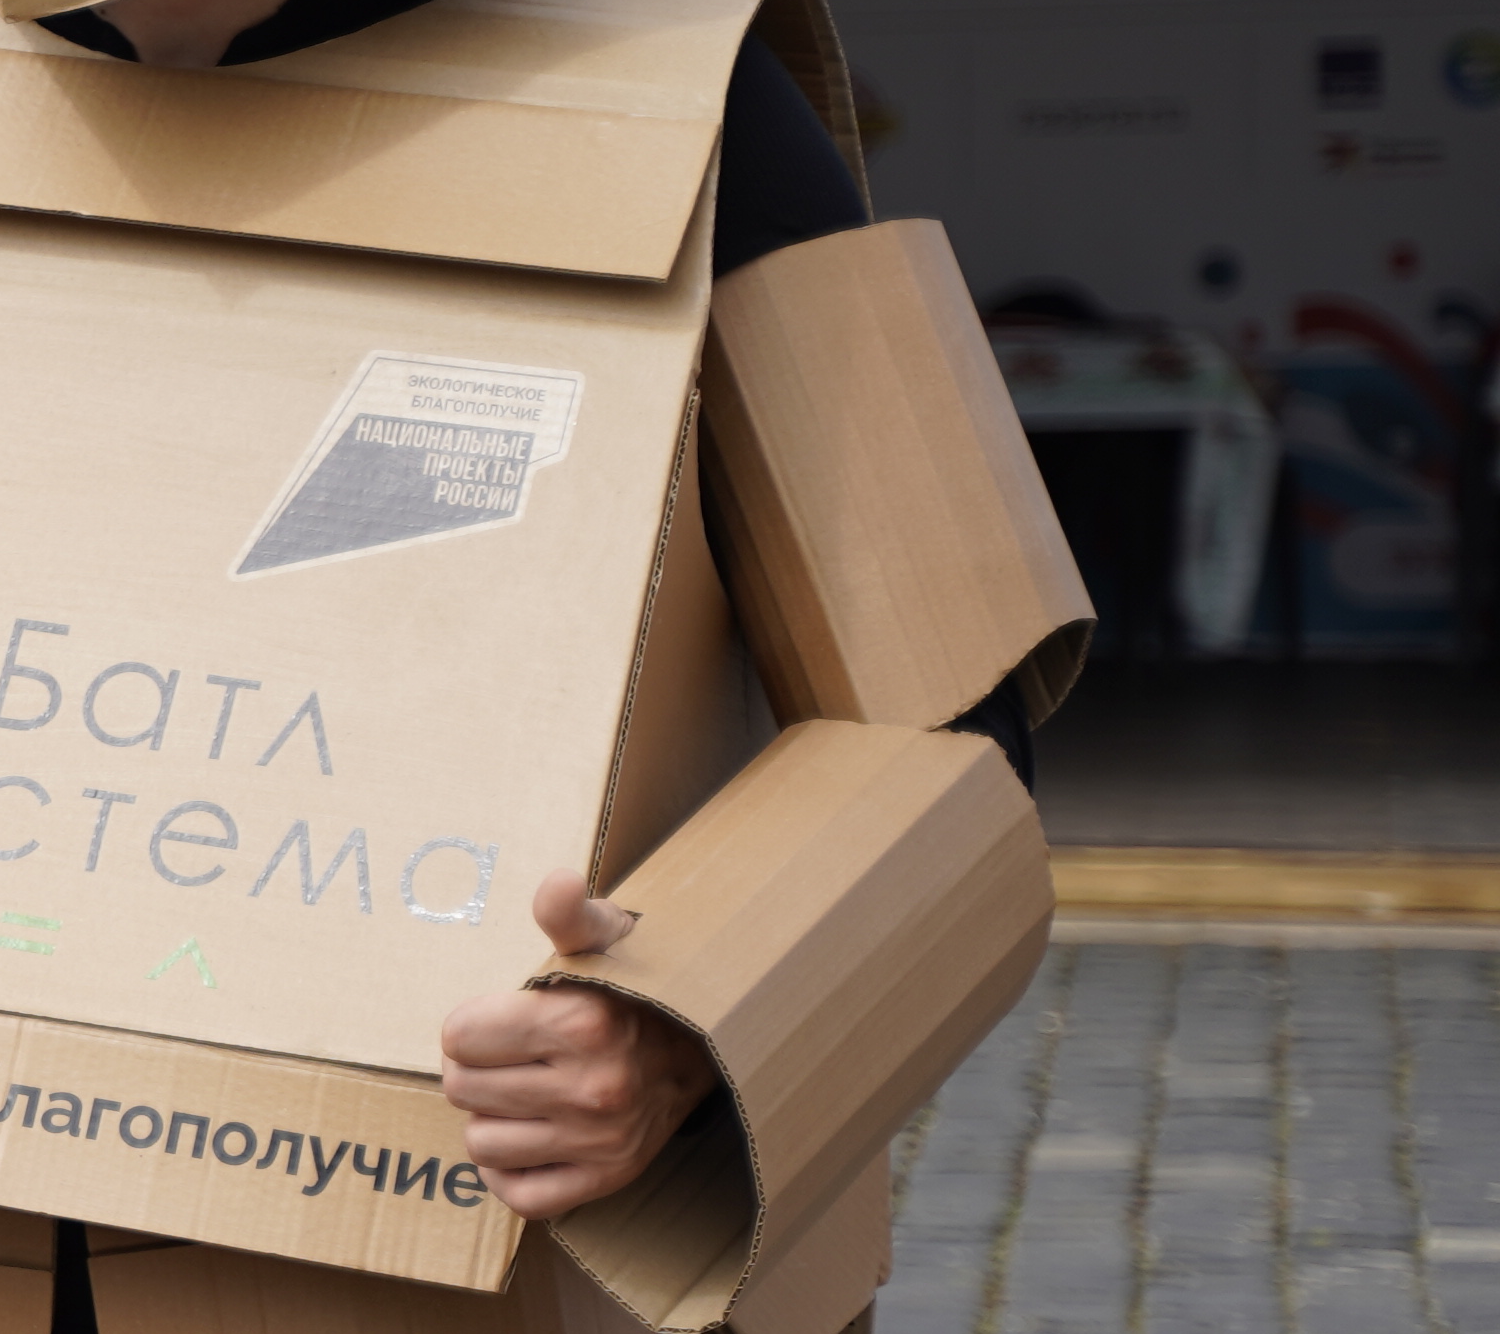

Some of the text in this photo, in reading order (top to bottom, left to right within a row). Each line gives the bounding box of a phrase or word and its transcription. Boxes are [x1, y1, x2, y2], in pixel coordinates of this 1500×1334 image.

[408, 375, 546, 402] ЭКОЛОГИЧЕСКОЕ
[412, 396, 542, 421] БЛАГОПОЛУЧИЕ
[356, 419, 529, 459] НАЦИОНАЛЬНЫЕ
[423, 454, 524, 485] ПРОЕКТЫ
[434, 481, 516, 511] РОССИИ
